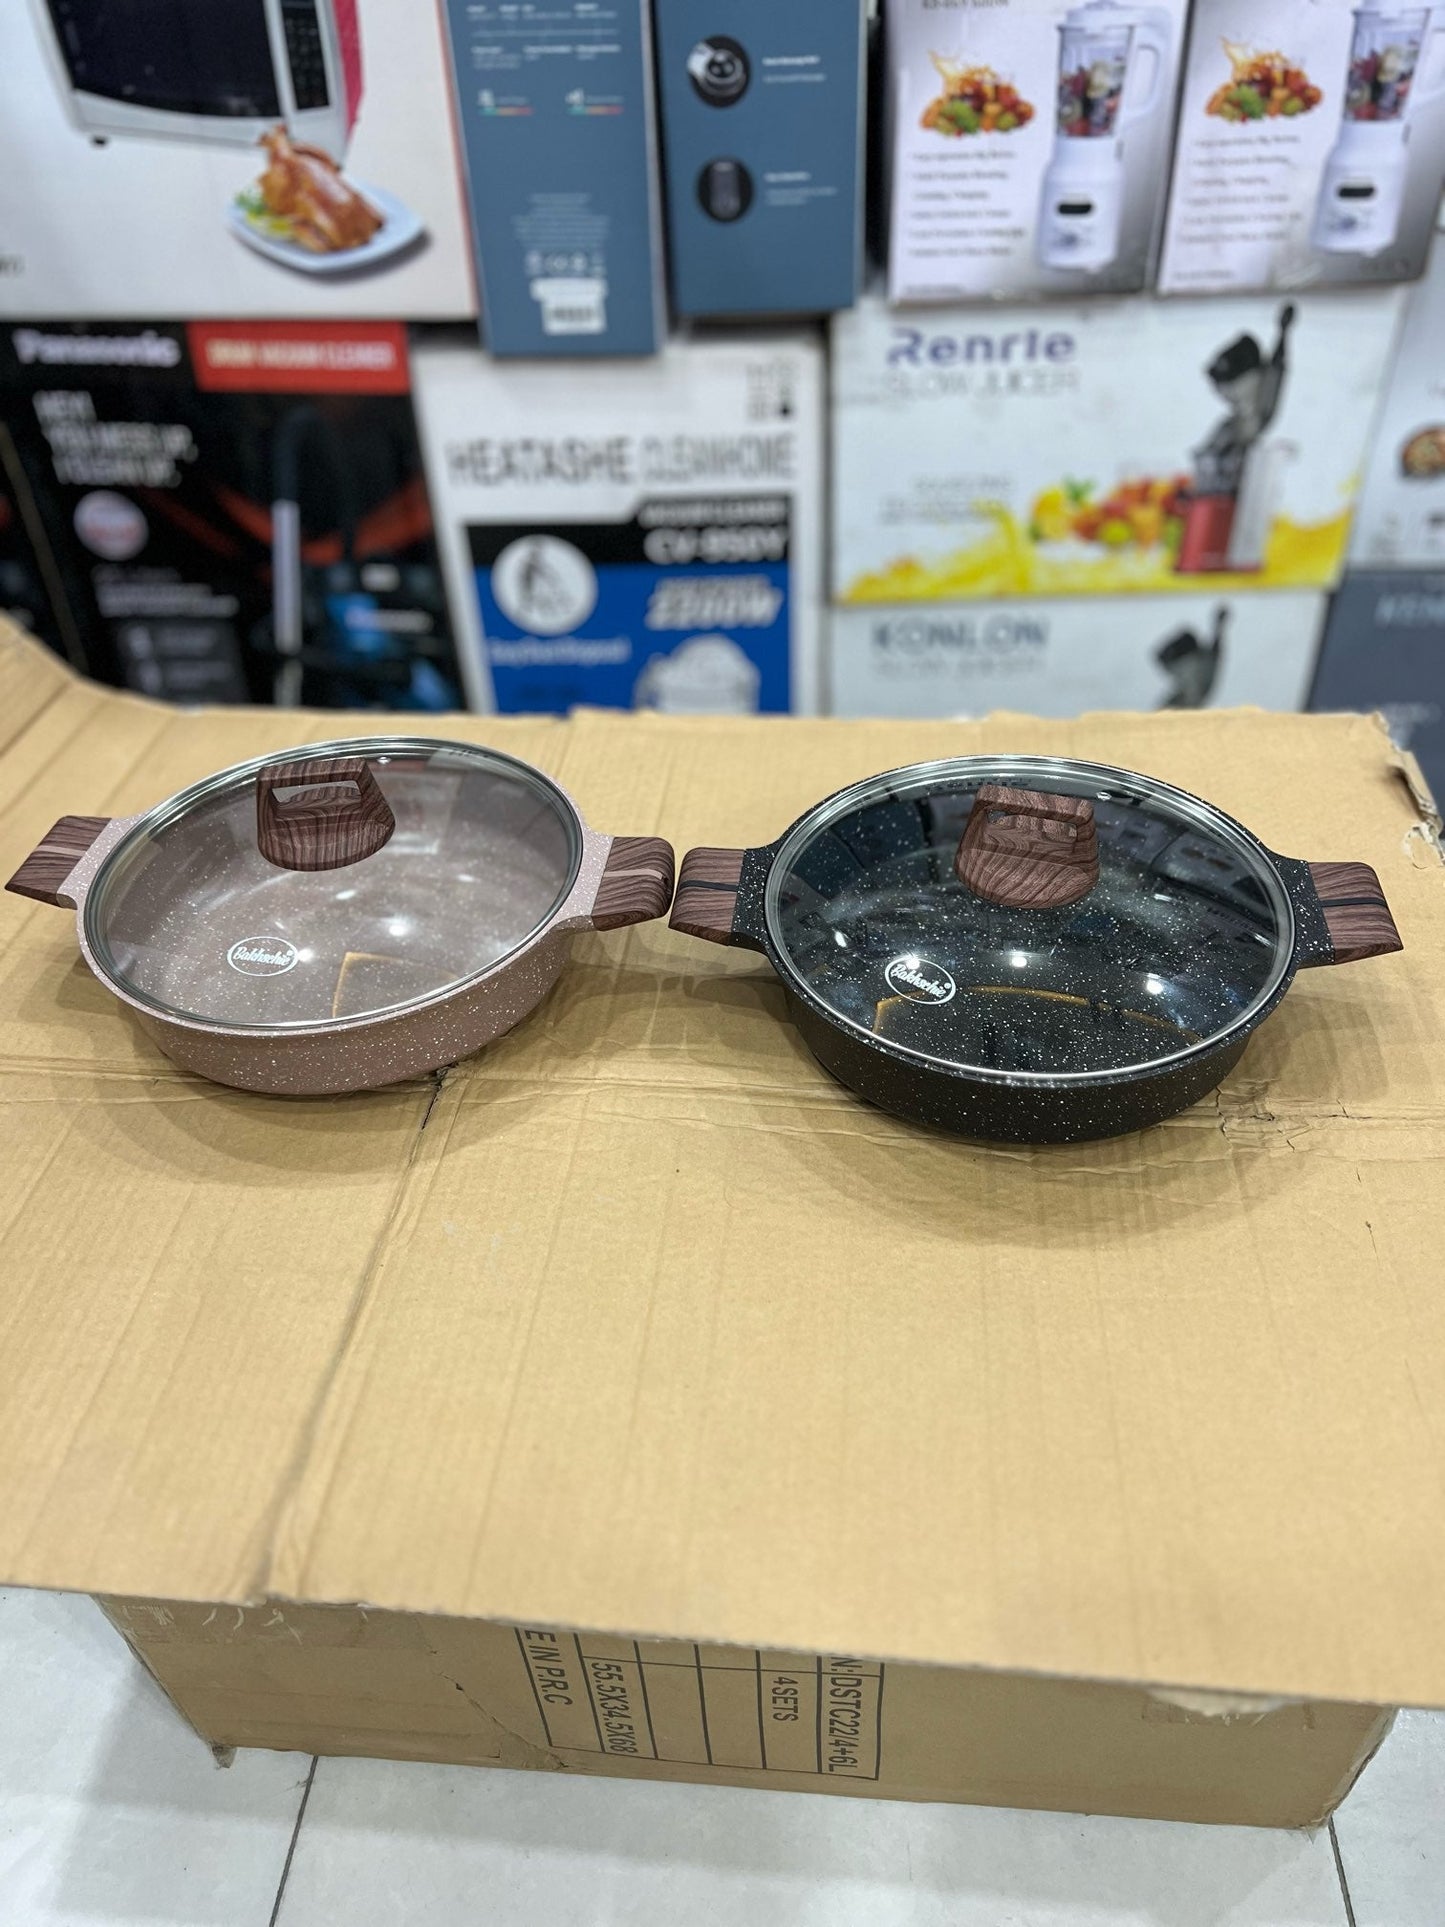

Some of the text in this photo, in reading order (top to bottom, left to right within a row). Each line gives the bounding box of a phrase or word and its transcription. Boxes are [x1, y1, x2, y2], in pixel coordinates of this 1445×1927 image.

[528, 1644, 563, 1663] IN
[535, 1665, 574, 1706] P.R.C
[591, 1662, 639, 1754] 55.5X34.5X68
